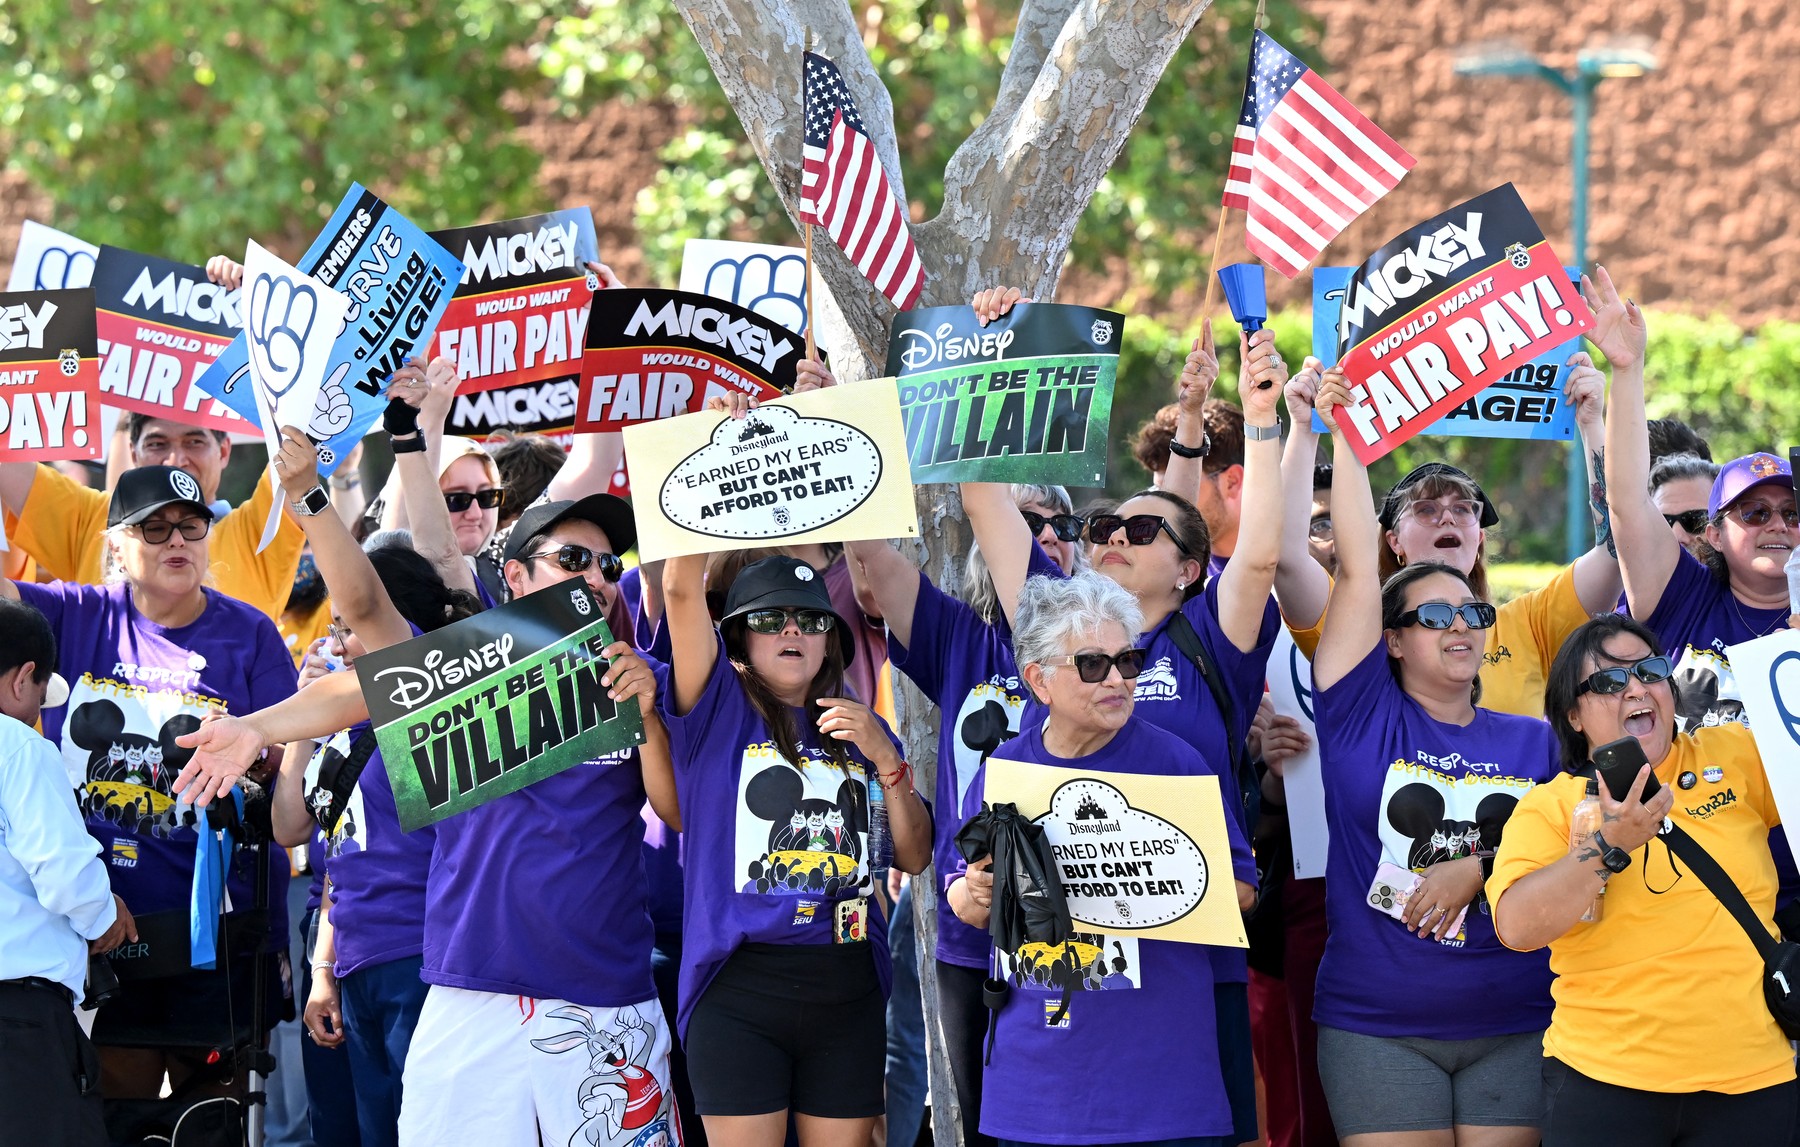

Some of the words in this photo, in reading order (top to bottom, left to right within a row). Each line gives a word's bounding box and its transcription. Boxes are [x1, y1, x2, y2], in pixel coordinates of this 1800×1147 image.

[460, 220, 578, 285] MICKEY
[1341, 212, 1487, 344] MICKEY
[122, 266, 244, 328] MICK
[358, 249, 427, 347] Living
[476, 295, 527, 317] WOULD
[529, 288, 571, 308] WANT
[354, 265, 447, 398] WAGE!
[1369, 310, 1439, 360] WOULD
[1437, 276, 1496, 318] WANT
[136, 327, 202, 353] WOULD
[439, 319, 517, 381] FAIR
[623, 298, 794, 374] MICKEY
[354, 346, 368, 361] a
[1346, 341, 1465, 446] FAIR
[1445, 275, 1574, 377] PAY!
[0, 370, 39, 386] ANT
[642, 353, 711, 371] WOULD
[713, 363, 763, 397] WANT
[900, 373, 984, 407] DON'T
[987, 369, 1030, 393] BE
[1036, 365, 1101, 388] THE
[587, 371, 694, 422] FAIR
[1445, 395, 1559, 423] AGE!
[728, 431, 789, 456] Disneyland
[901, 387, 1095, 468] VILLAIN
[764, 449, 792, 468] MY
[797, 436, 853, 460] EARS"
[719, 475, 758, 496] BUT
[763, 461, 822, 486] CAN'T
[700, 490, 778, 520] AFFORD
[780, 484, 808, 502] TO
[810, 475, 855, 496] EAT!
[81, 671, 148, 700] BETTER
[112, 662, 201, 687] RESPECT!
[407, 685, 500, 748] DON'T
[505, 668, 545, 700] BE
[549, 633, 605, 678] THE
[1133, 684, 1177, 698] SEIU
[411, 661, 618, 810] VILLAIN
[1393, 758, 1457, 789] BETTER
[1463, 770, 1535, 789] WAGES!
[1416, 750, 1500, 773] RESPECT!
[1067, 820, 1122, 835] Disneyland
[111, 857, 138, 869] SEIU
[1052, 843, 1098, 860] RNED
[1100, 842, 1125, 858] MY
[1130, 838, 1179, 856] EARS"
[1062, 863, 1098, 879] BUT
[1101, 861, 1153, 878] CAN'T
[1062, 882, 1118, 898] FFORD
[1119, 881, 1144, 897] TO
[1145, 880, 1185, 896] EAT!
[793, 916, 813, 926] SEIU
